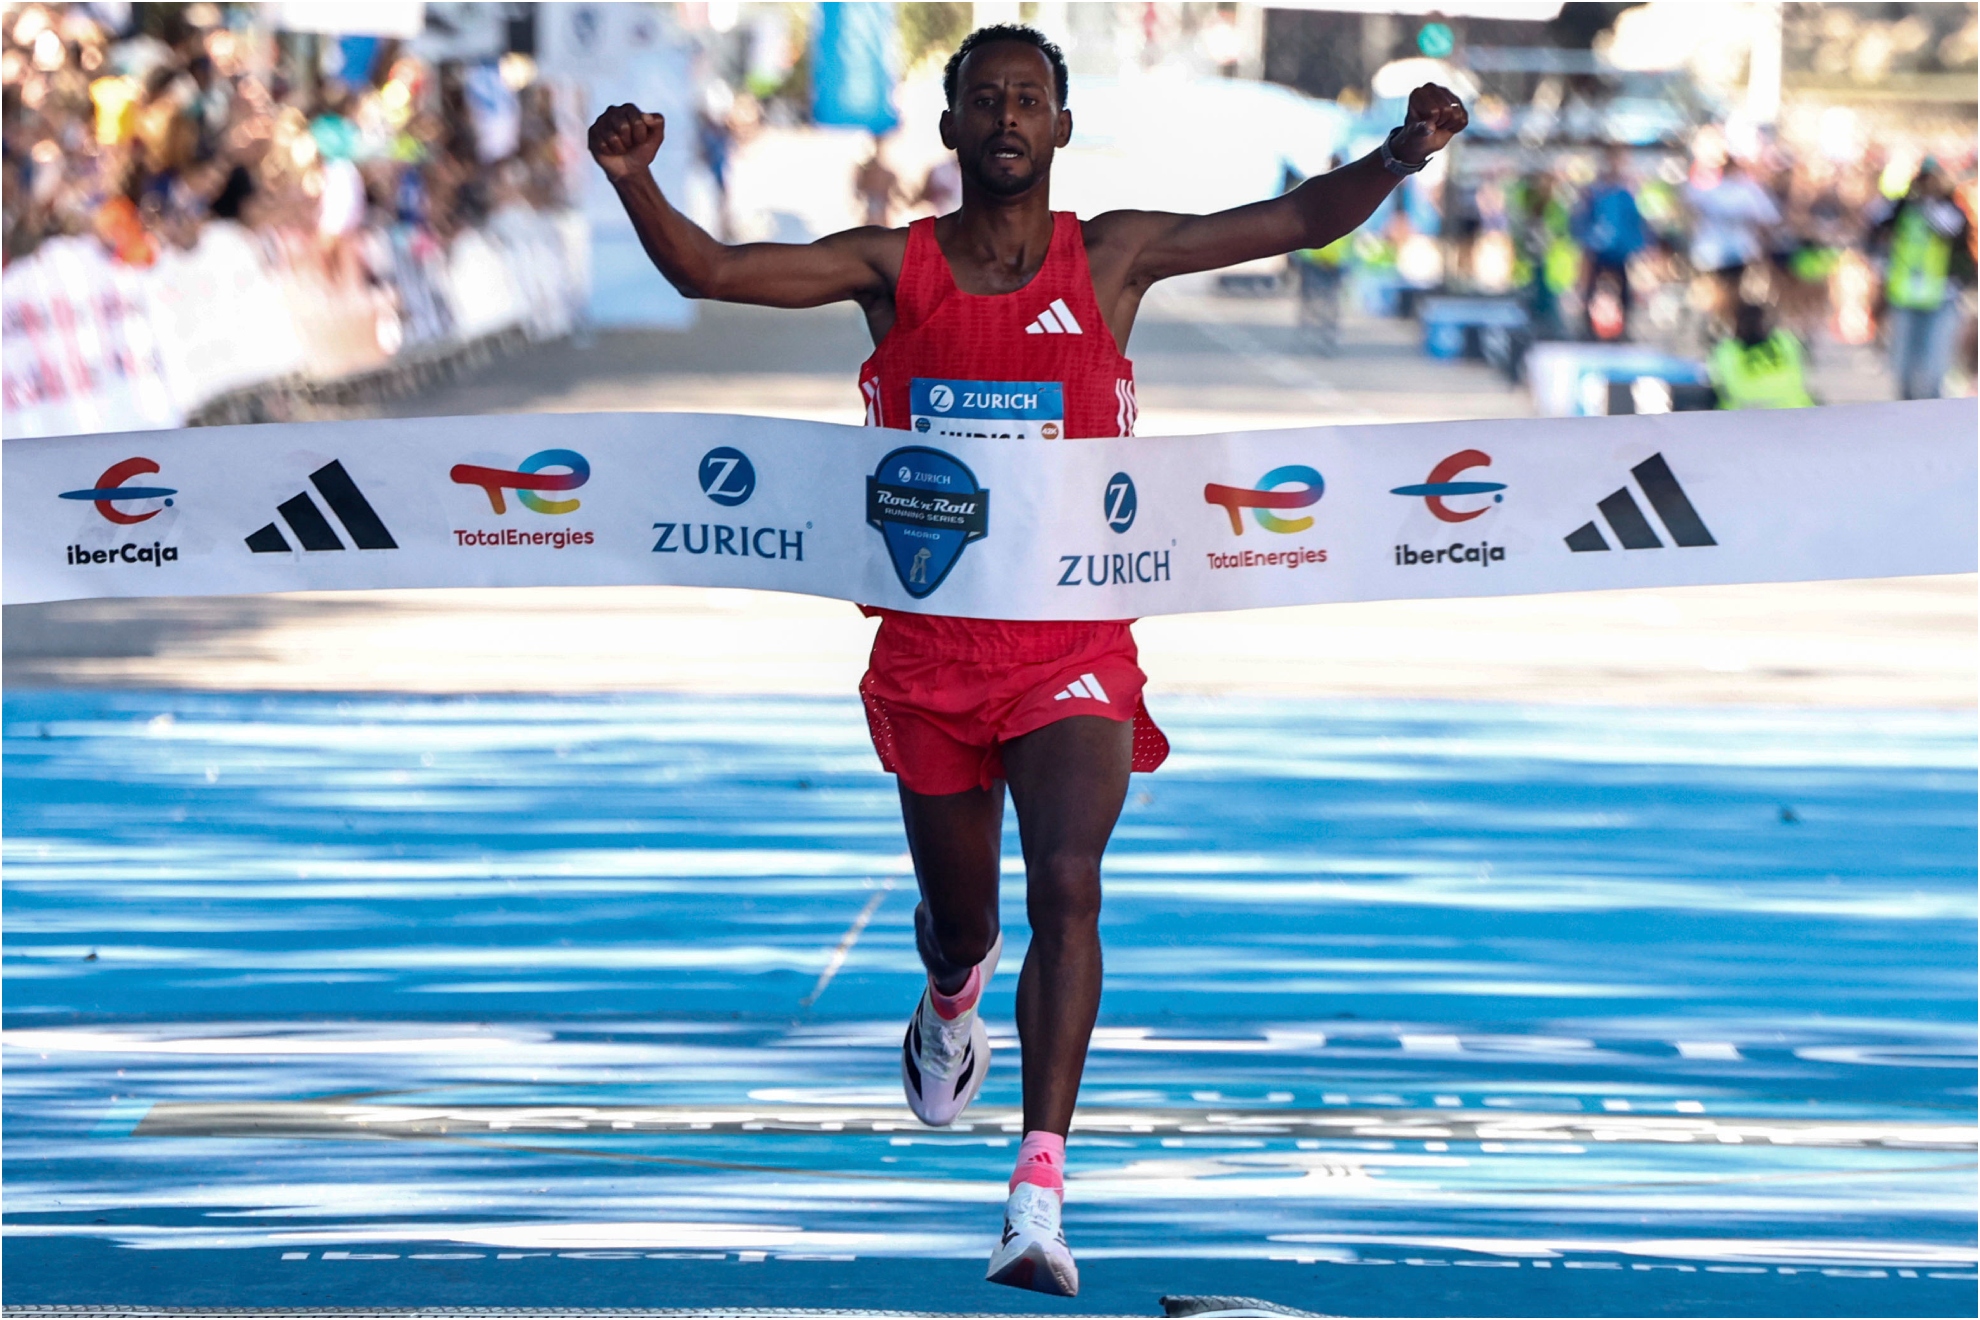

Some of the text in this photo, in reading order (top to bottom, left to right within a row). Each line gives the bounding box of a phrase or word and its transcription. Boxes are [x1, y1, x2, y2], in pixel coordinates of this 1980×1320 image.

[962, 392, 1038, 410] ZURICH
[914, 472, 951, 485] ZURICH
[885, 507, 965, 525] RUNNING SERIES
[454, 528, 594, 549] TotalEnergies
[651, 522, 804, 562] ZURICH
[903, 529, 941, 541] MADRID
[67, 542, 178, 567] iberCaja
[1207, 547, 1328, 570] TotalEnergies
[1395, 541, 1505, 567] iberCaja
[1056, 550, 1171, 586] ZURICH
